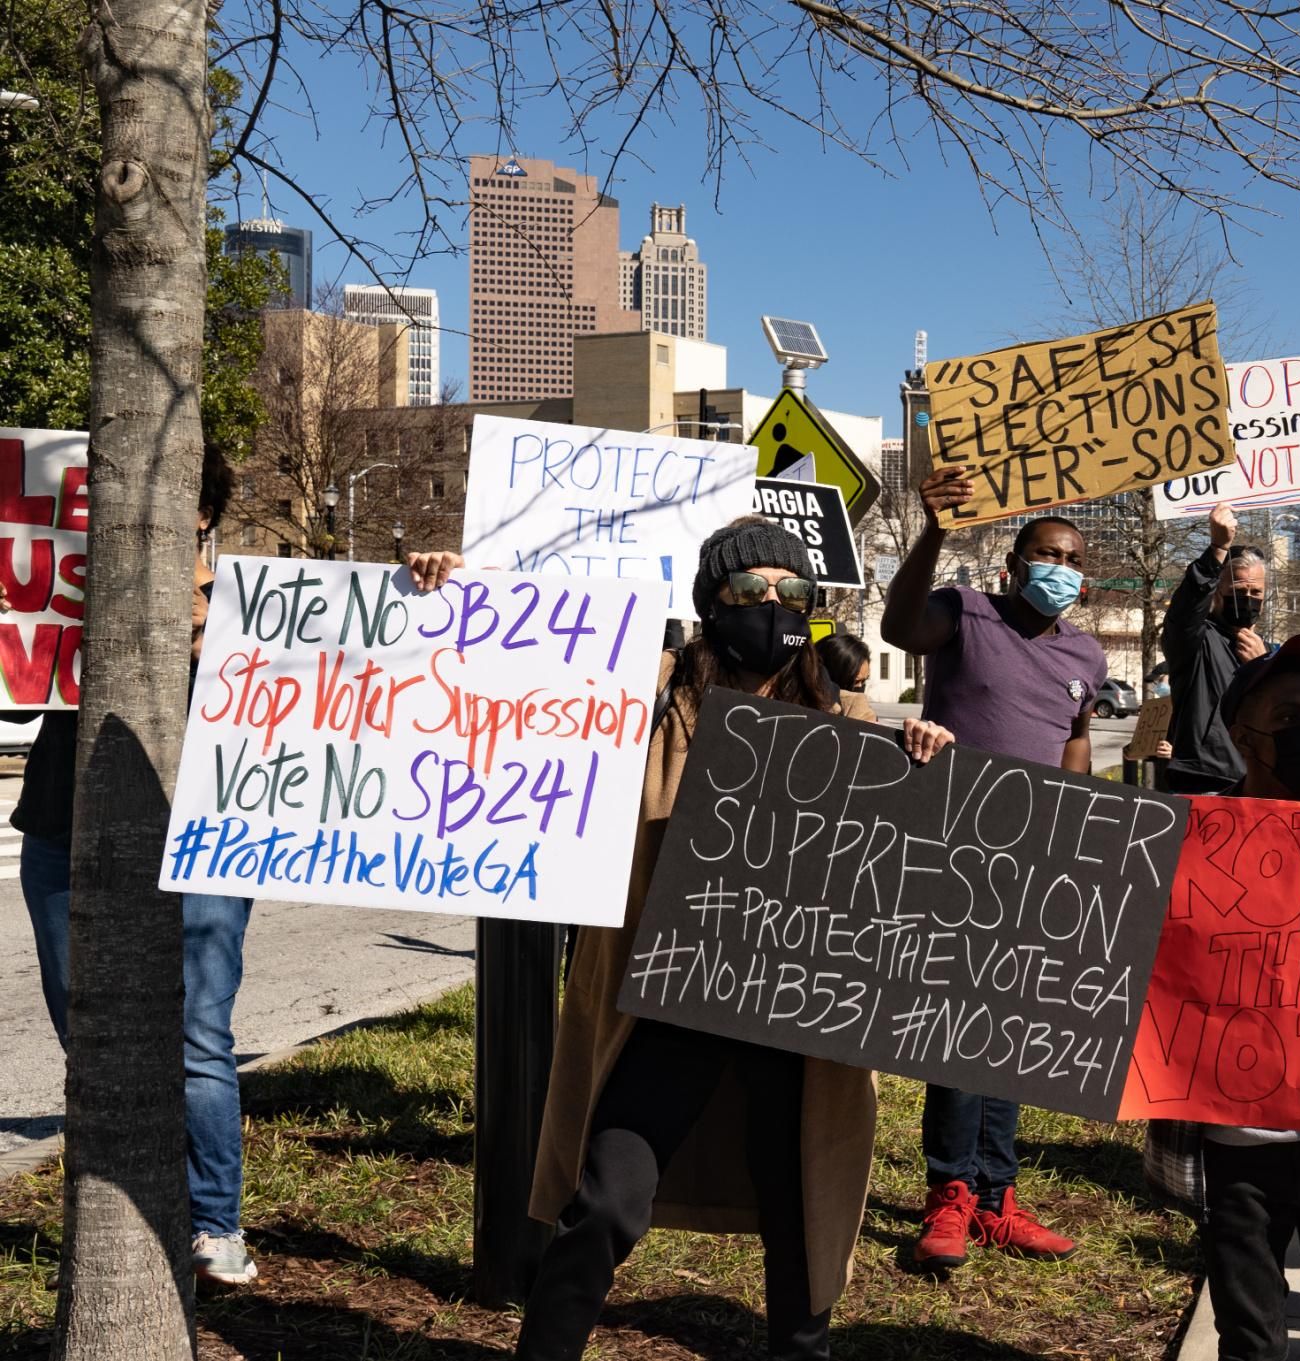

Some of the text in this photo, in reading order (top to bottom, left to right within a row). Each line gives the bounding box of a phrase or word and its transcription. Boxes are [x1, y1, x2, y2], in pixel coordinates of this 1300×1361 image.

[503, 165, 520, 174] GP
[240, 222, 282, 234] WESTIN
[935, 364, 1221, 463] ELECTIONS
[510, 433, 717, 505] PROTECT
[564, 506, 638, 544] THE
[234, 561, 639, 673] Vote No SB241
[782, 633, 807, 647] VOTE
[201, 646, 650, 780] Stop Voter Suppression
[214, 738, 603, 840] Vote No SB241
[706, 705, 1177, 888] STOP VOTER
[690, 795, 1133, 963] SUPPRESSION
[685, 876, 1132, 1026] #PROTECTTHEVOTEGA
[892, 995, 1124, 1096] #NOSB241
